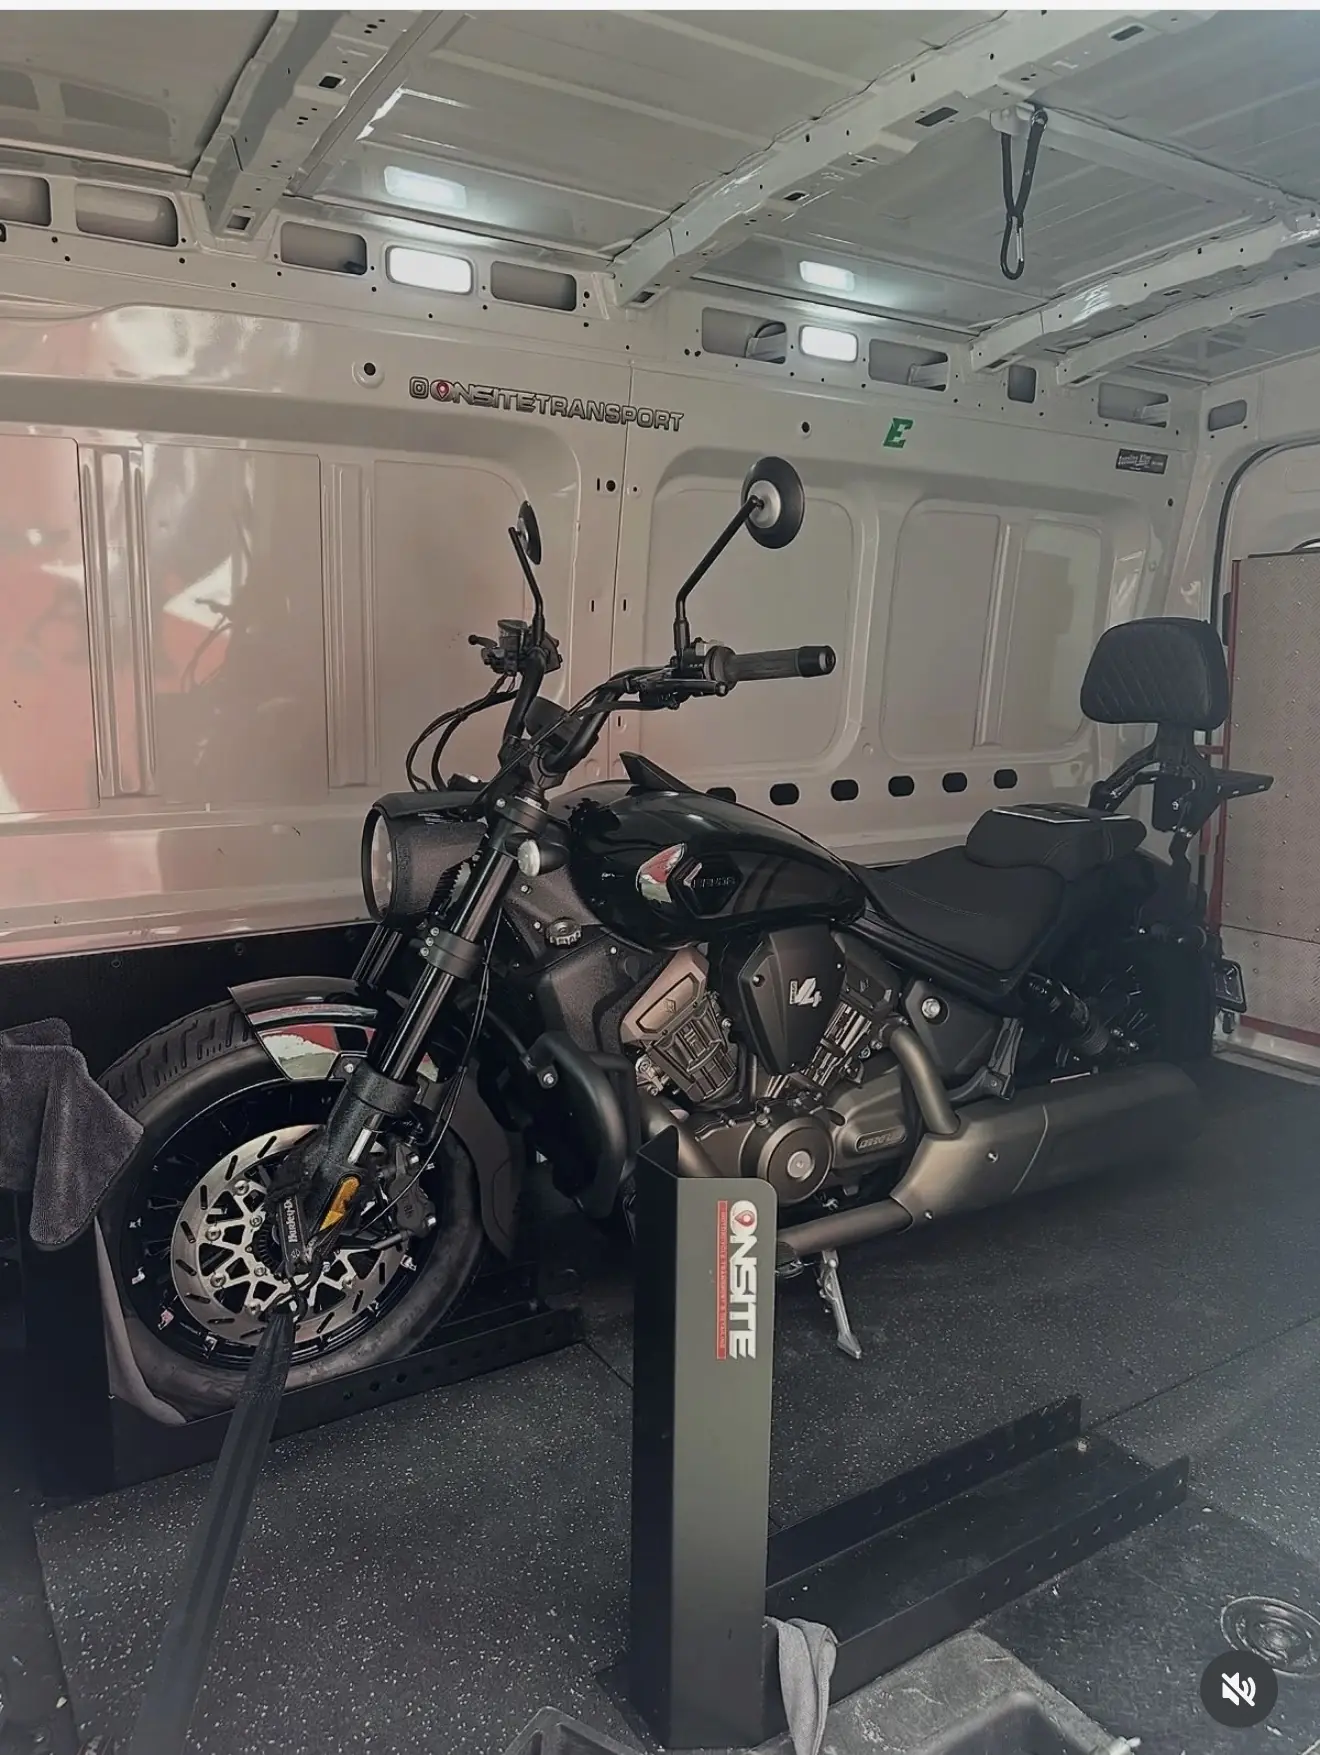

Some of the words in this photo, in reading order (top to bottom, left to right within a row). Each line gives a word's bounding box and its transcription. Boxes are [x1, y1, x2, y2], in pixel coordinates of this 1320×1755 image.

[883, 417, 914, 448] E
[789, 977, 822, 1008] V4
[729, 1200, 758, 1359] ONSITE
